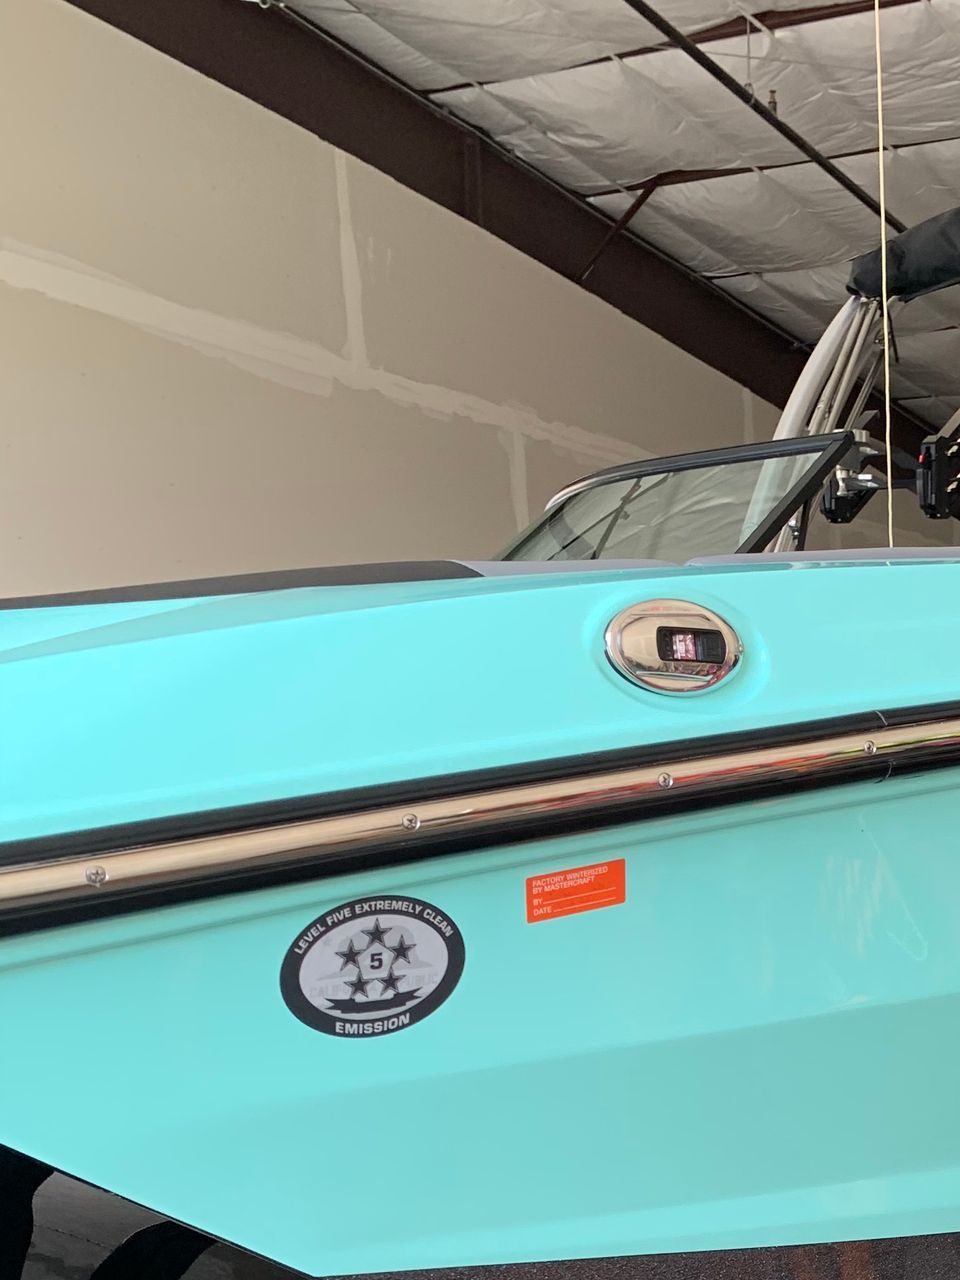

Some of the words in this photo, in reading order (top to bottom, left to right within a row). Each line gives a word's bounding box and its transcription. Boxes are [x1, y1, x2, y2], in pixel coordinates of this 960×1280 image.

[532, 874, 565, 887] FACTORY
[566, 866, 608, 880] WINTERIZED
[544, 876, 595, 891] MASTERCRAFT
[533, 898, 543, 906] BY
[533, 906, 552, 916] DATE
[294, 922, 326, 955] LEVEL
[326, 908, 352, 927] FIVE
[355, 900, 424, 915] EXTREMELY
[423, 909, 454, 937] CLEAN
[370, 952, 383, 970] 5
[335, 1013, 410, 1035] EMISSION
